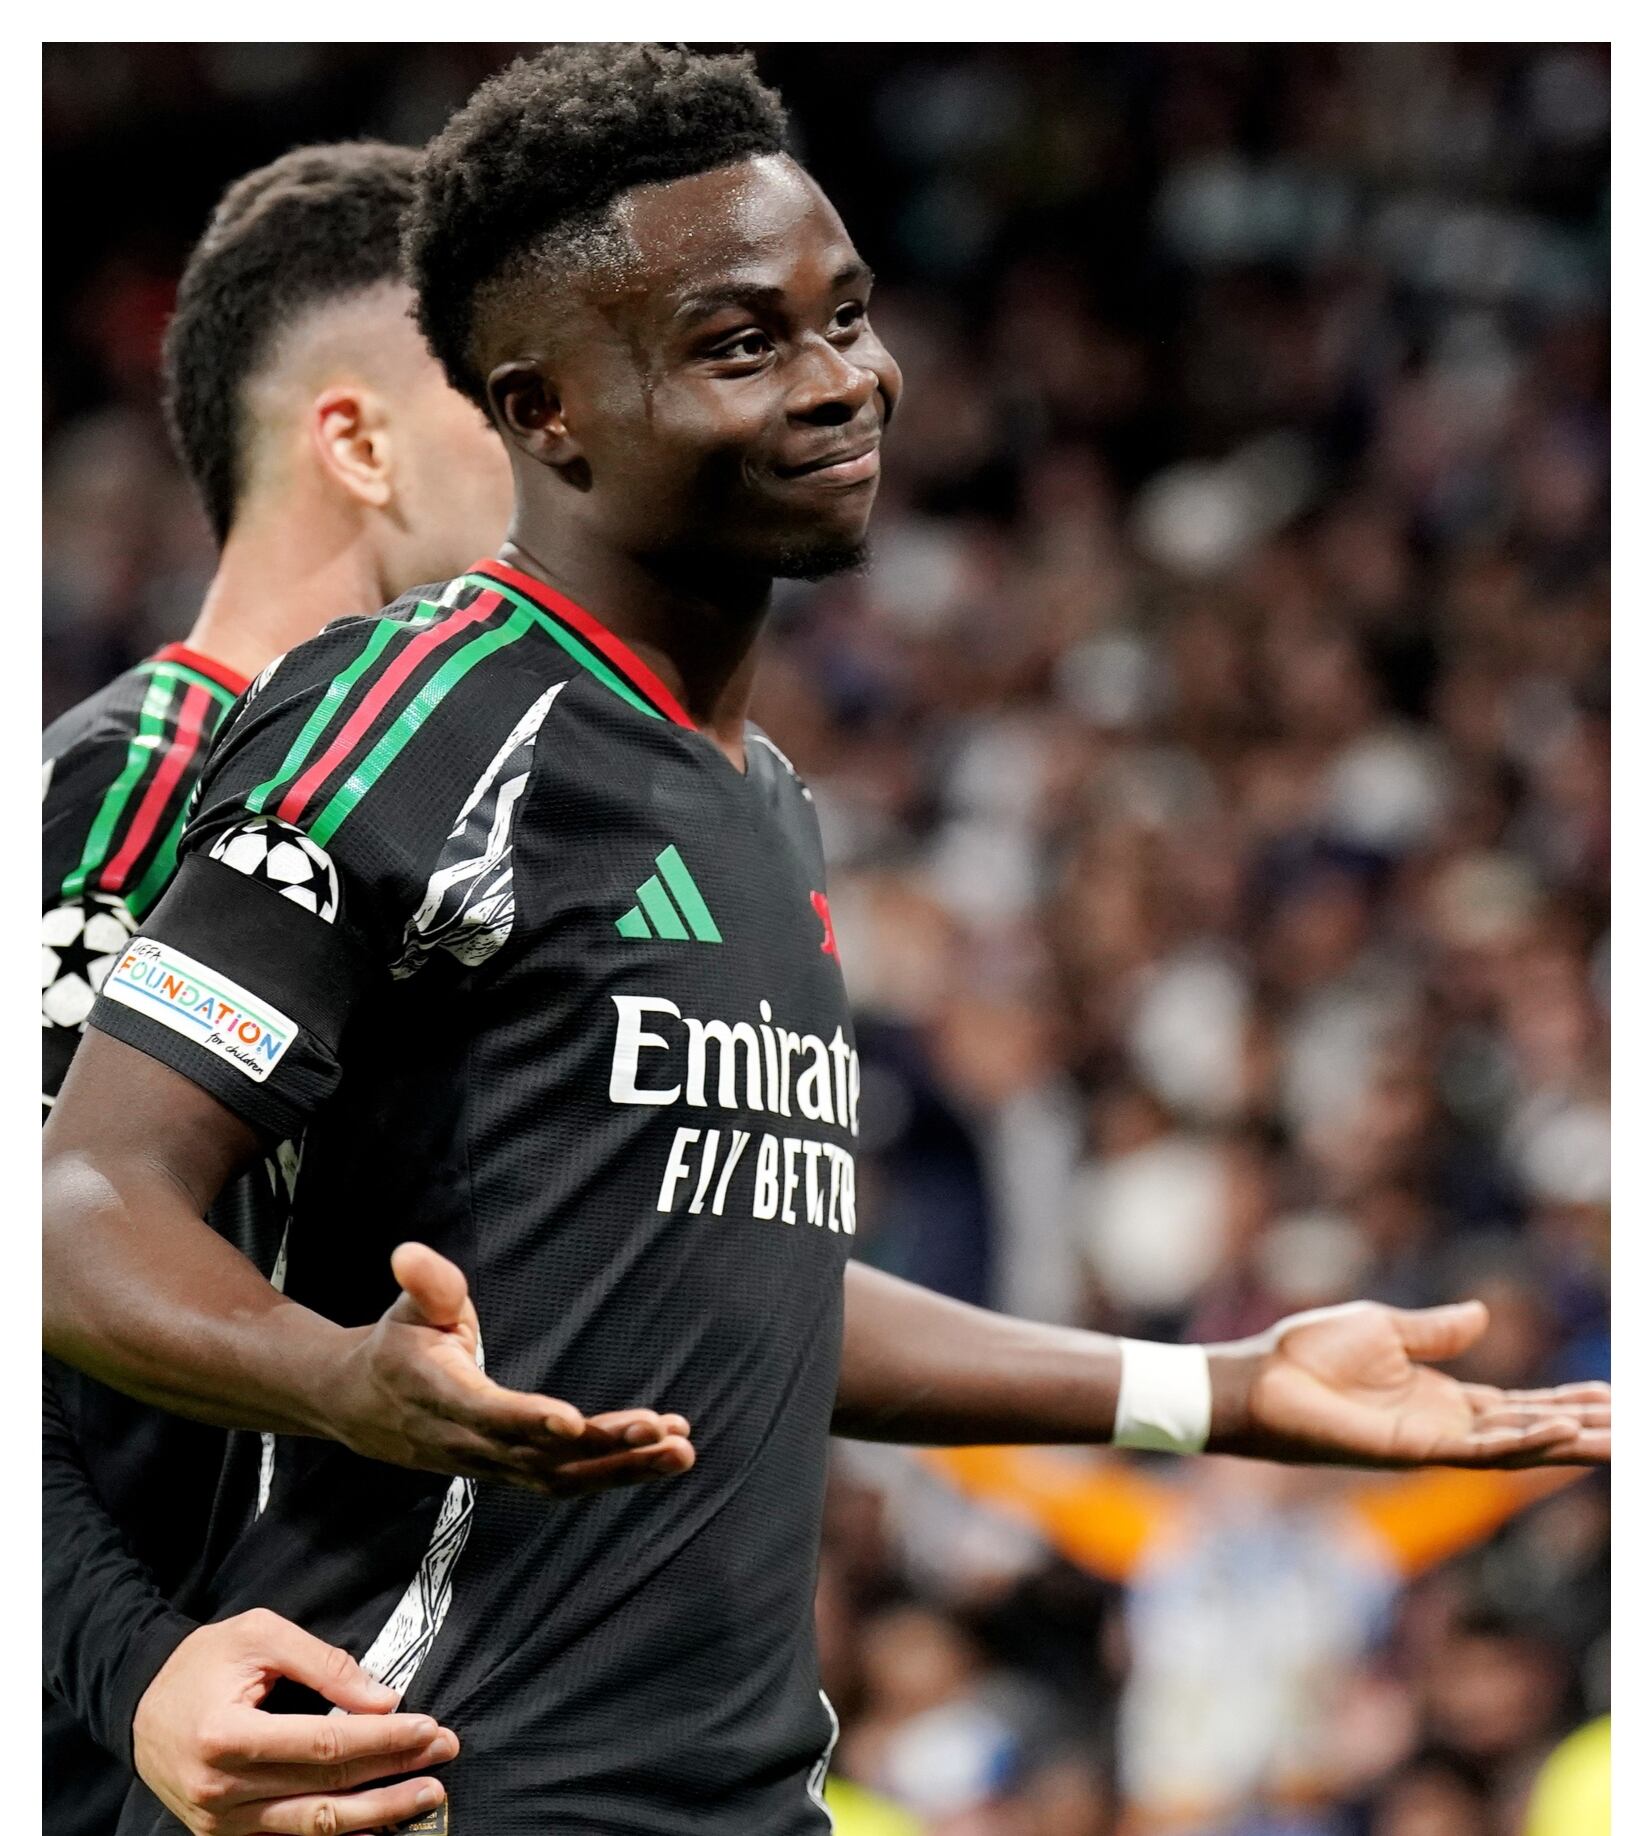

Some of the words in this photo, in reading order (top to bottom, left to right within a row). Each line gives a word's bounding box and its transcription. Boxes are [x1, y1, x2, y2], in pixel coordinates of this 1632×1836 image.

[133, 944, 161, 962] UEFA
[204, 1032, 225, 1044] for
[225, 1045, 264, 1075] children
[657, 1126, 751, 1216] FLY
